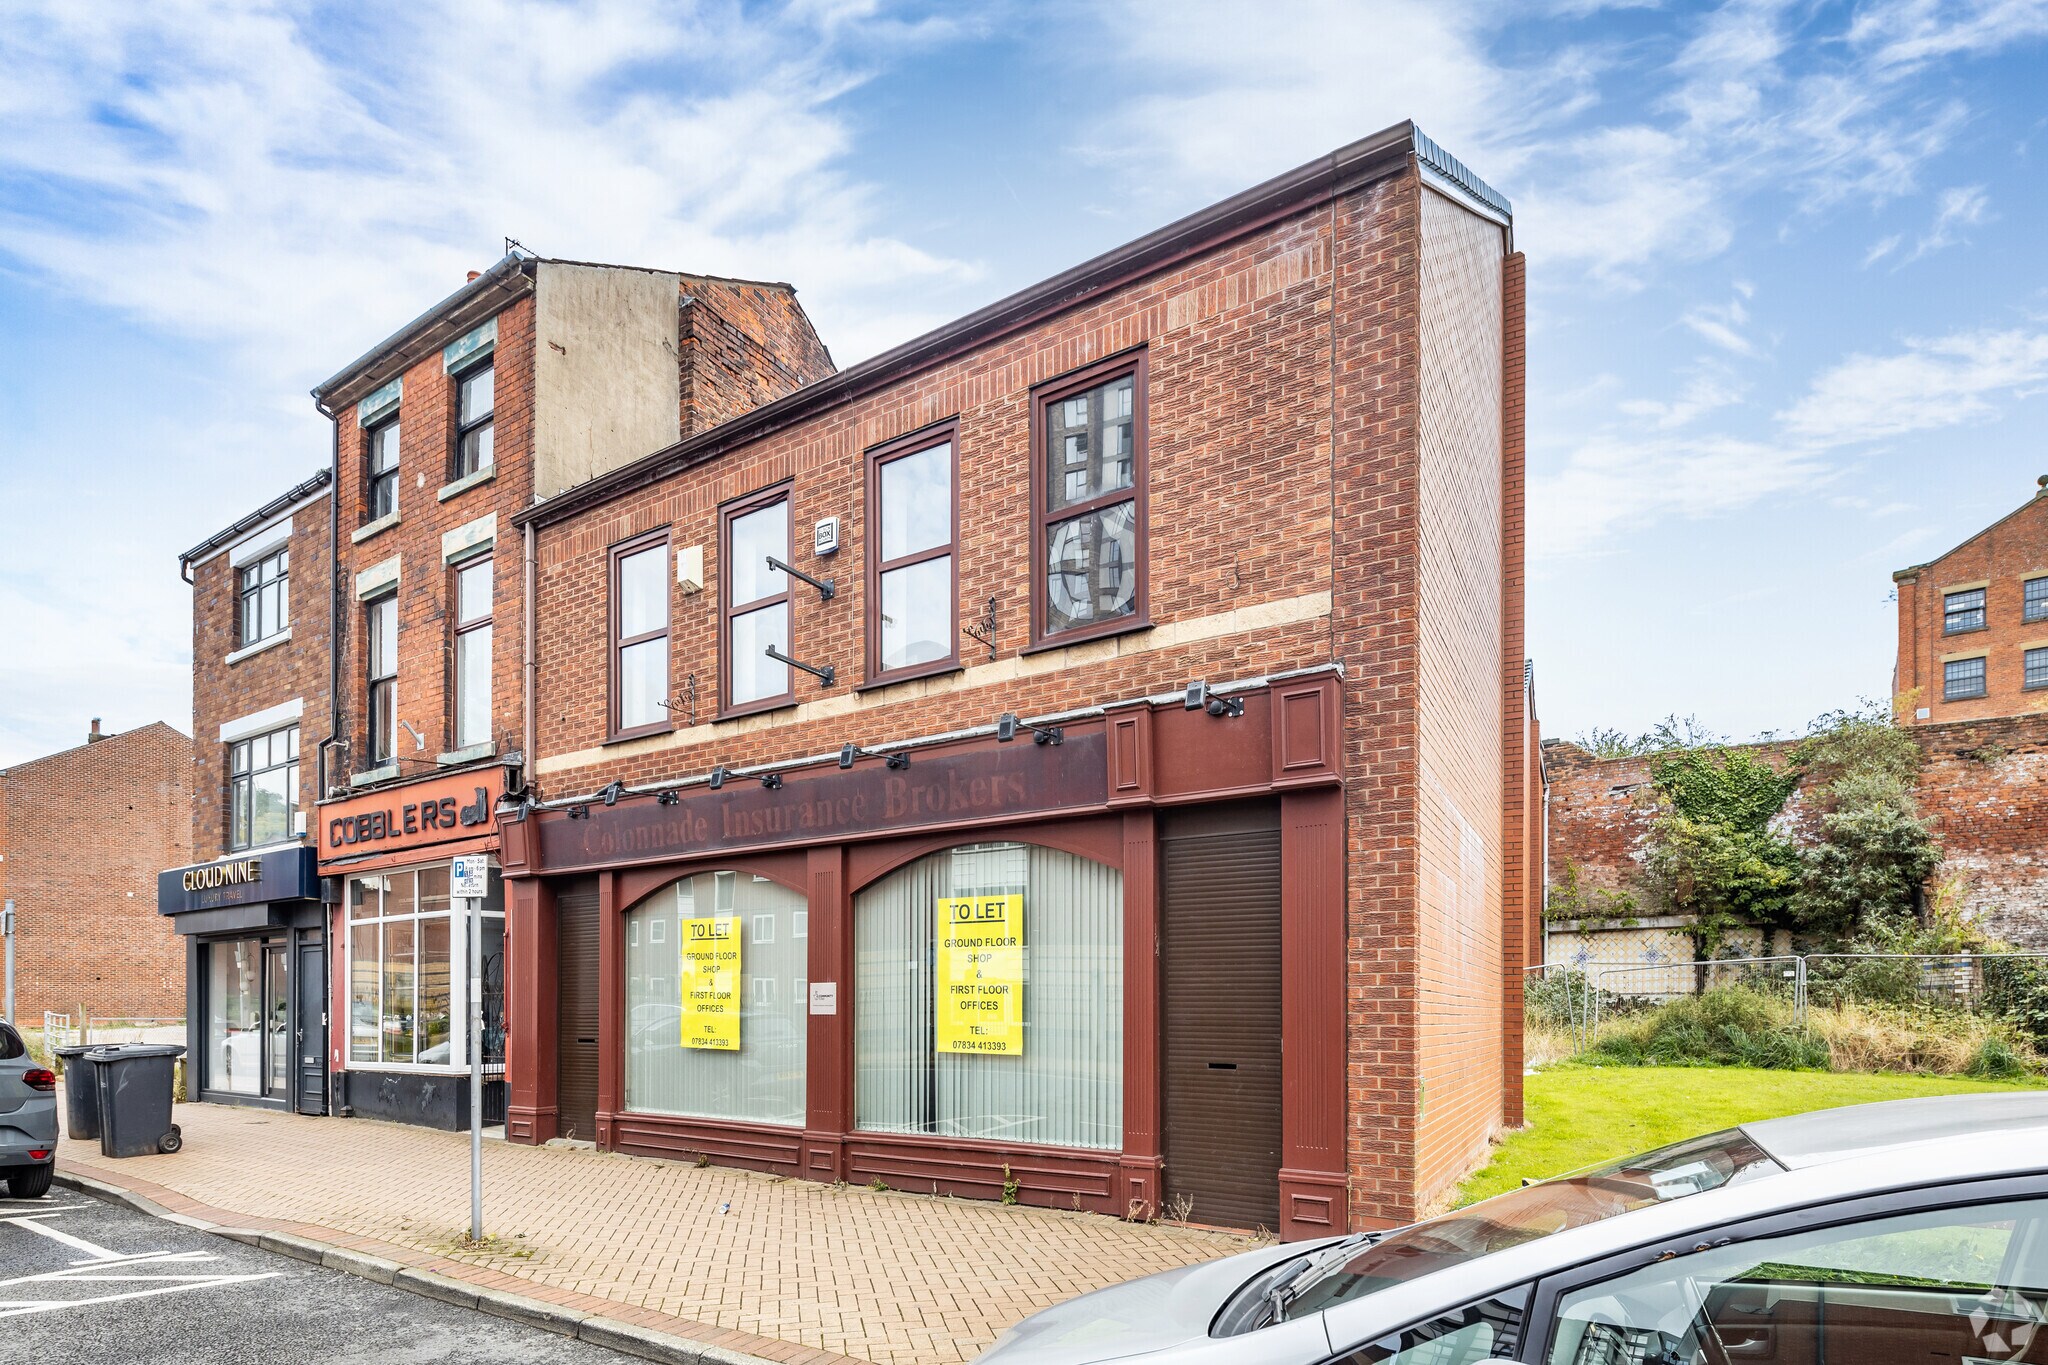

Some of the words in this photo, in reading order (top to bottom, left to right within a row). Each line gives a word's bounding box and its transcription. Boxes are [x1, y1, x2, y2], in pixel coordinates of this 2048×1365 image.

[583, 808, 708, 856] Colonnade
[721, 794, 866, 838] Insurance
[882, 768, 1026, 819] Brokers
[330, 797, 456, 848] COBBLERS
[182, 865, 223, 891] CLOUD
[225, 860, 255, 885] NINE
[223, 889, 243, 900] TRAVEL
[949, 904, 971, 920] TO
[976, 902, 1005, 919] LET
[691, 924, 705, 938] TO
[708, 923, 730, 937] LET
[944, 938, 983, 948] GROUND
[985, 937, 1017, 947] FLOOR
[686, 952, 714, 961] GROUND
[715, 951, 737, 960] FLOOR
[967, 953, 993, 963] SHOP
[702, 965, 721, 974] SHOP
[976, 969, 983, 979] &
[708, 978, 714, 987] &
[950, 985, 975, 995] FIRST
[977, 985, 1009, 995] FLOOR
[690, 991, 708, 1000] FIRST
[709, 991, 732, 1000] FLOOR
[696, 1004, 724, 1013] OFFICES
[960, 1001, 999, 1011] OFFICES
[703, 1025, 717, 1034] TEL:
[969, 1026, 989, 1035] TEL:
[691, 1037, 708, 1046] 07834
[709, 1038, 729, 1047] 413393
[952, 1040, 976, 1050] 07834
[977, 1041, 1007, 1051] 413393
